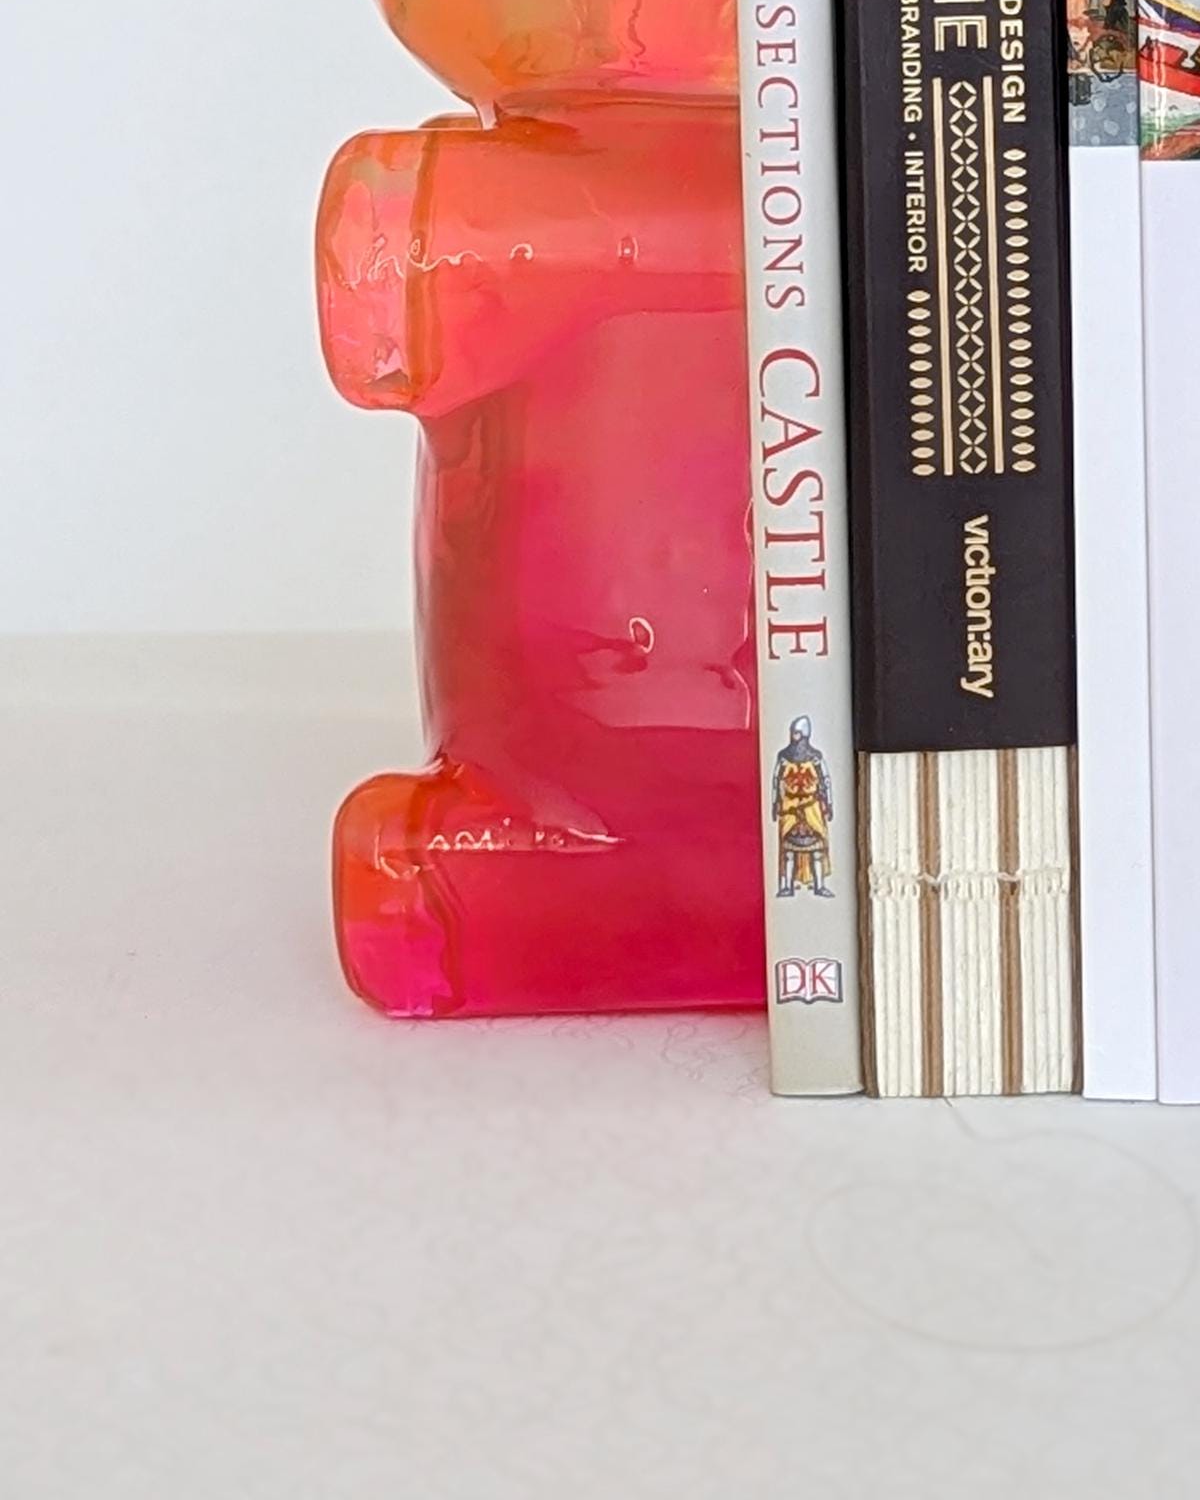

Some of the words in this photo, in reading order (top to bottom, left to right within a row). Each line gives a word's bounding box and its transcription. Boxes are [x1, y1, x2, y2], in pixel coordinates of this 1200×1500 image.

[904, 150, 928, 273] INTERIOR
[759, 348, 828, 661] CASTLE
[781, 961, 837, 996] DK
